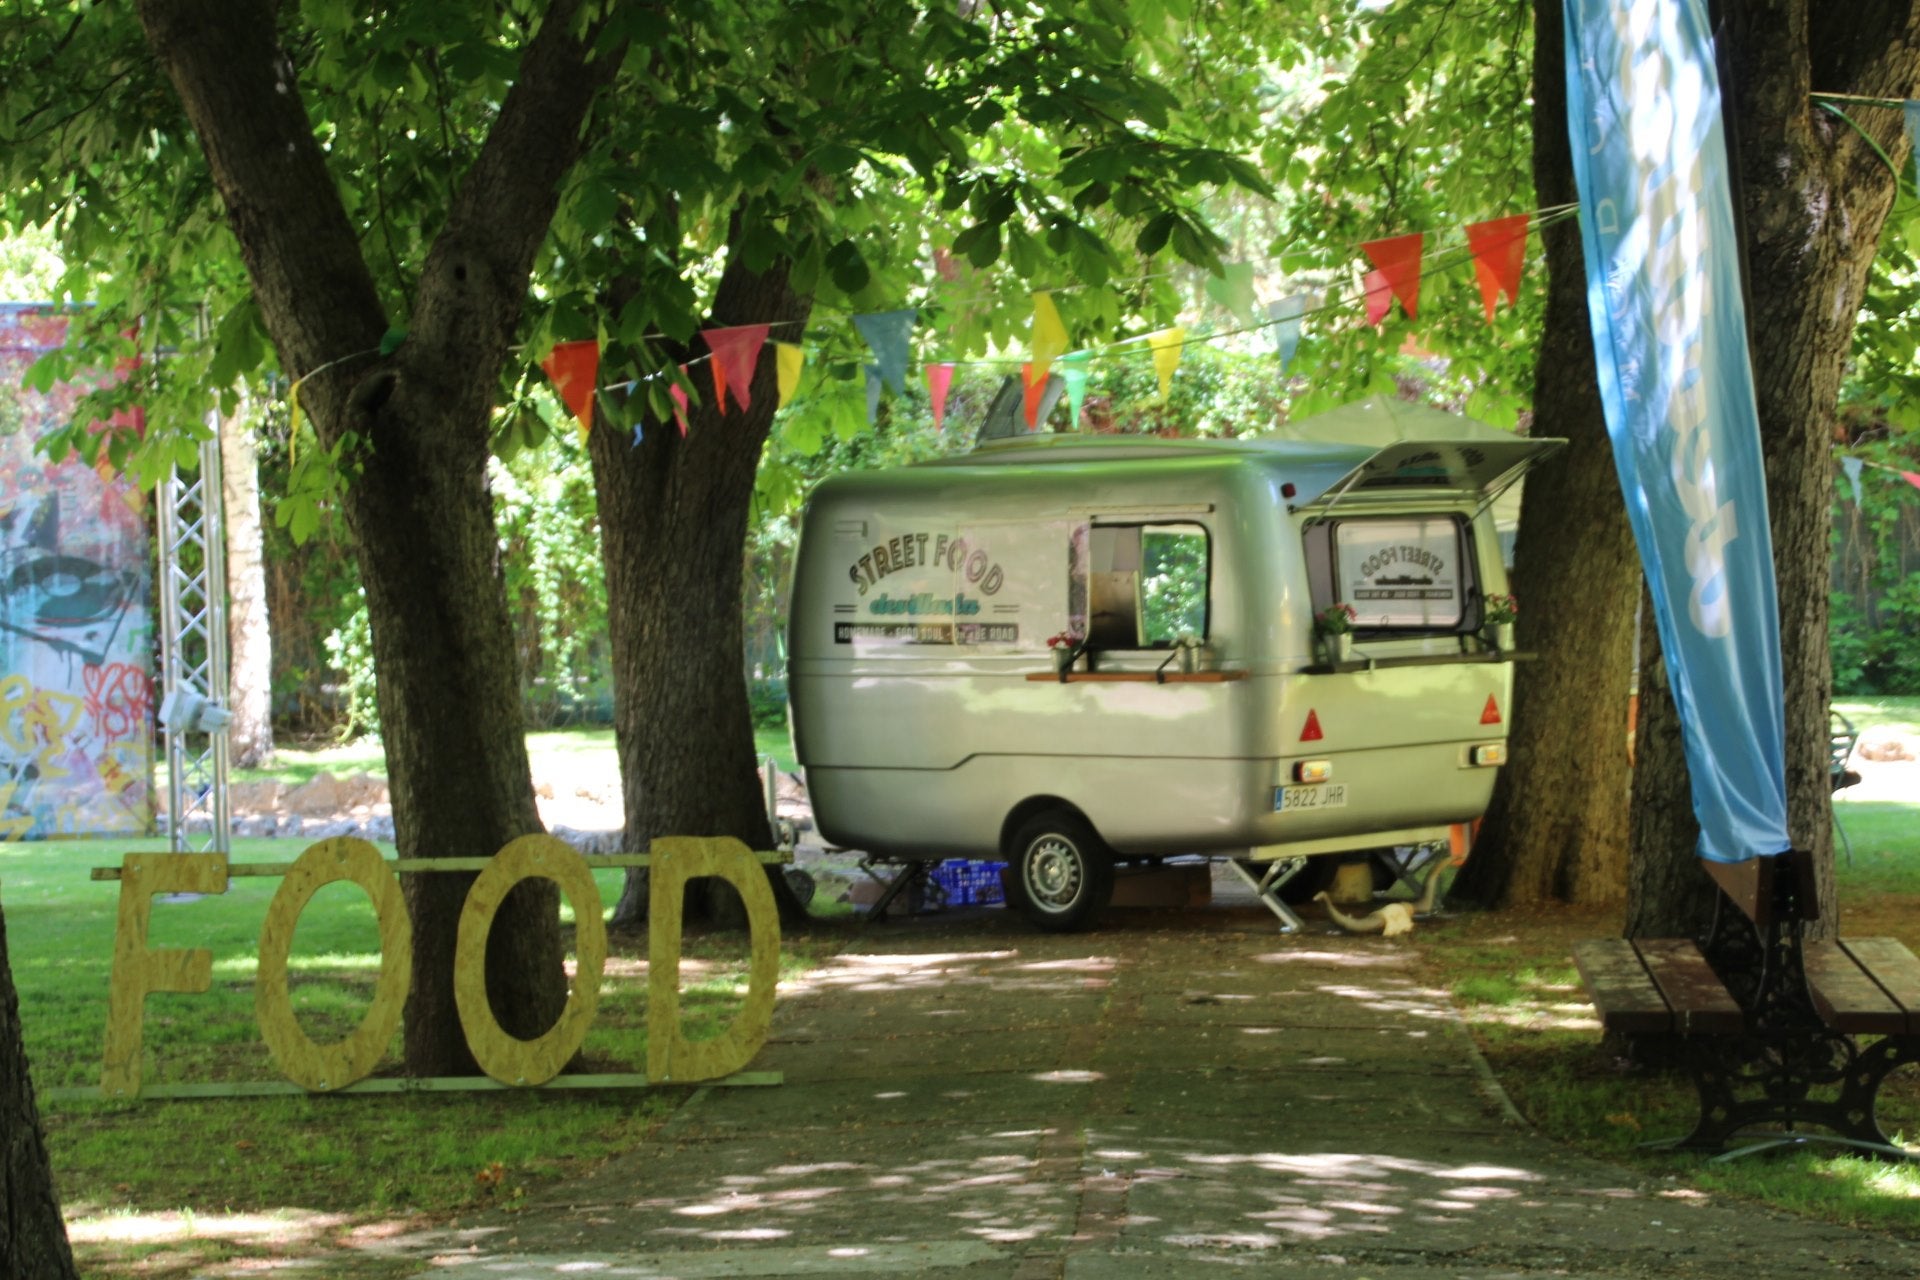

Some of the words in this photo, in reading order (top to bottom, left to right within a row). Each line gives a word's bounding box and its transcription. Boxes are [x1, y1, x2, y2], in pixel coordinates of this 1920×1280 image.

[849, 533, 929, 597] STREET
[933, 533, 1005, 597] FOOD
[1284, 787, 1318, 808] 5822
[1321, 785, 1345, 805] JHR
[100, 832, 782, 1098] FOOD
